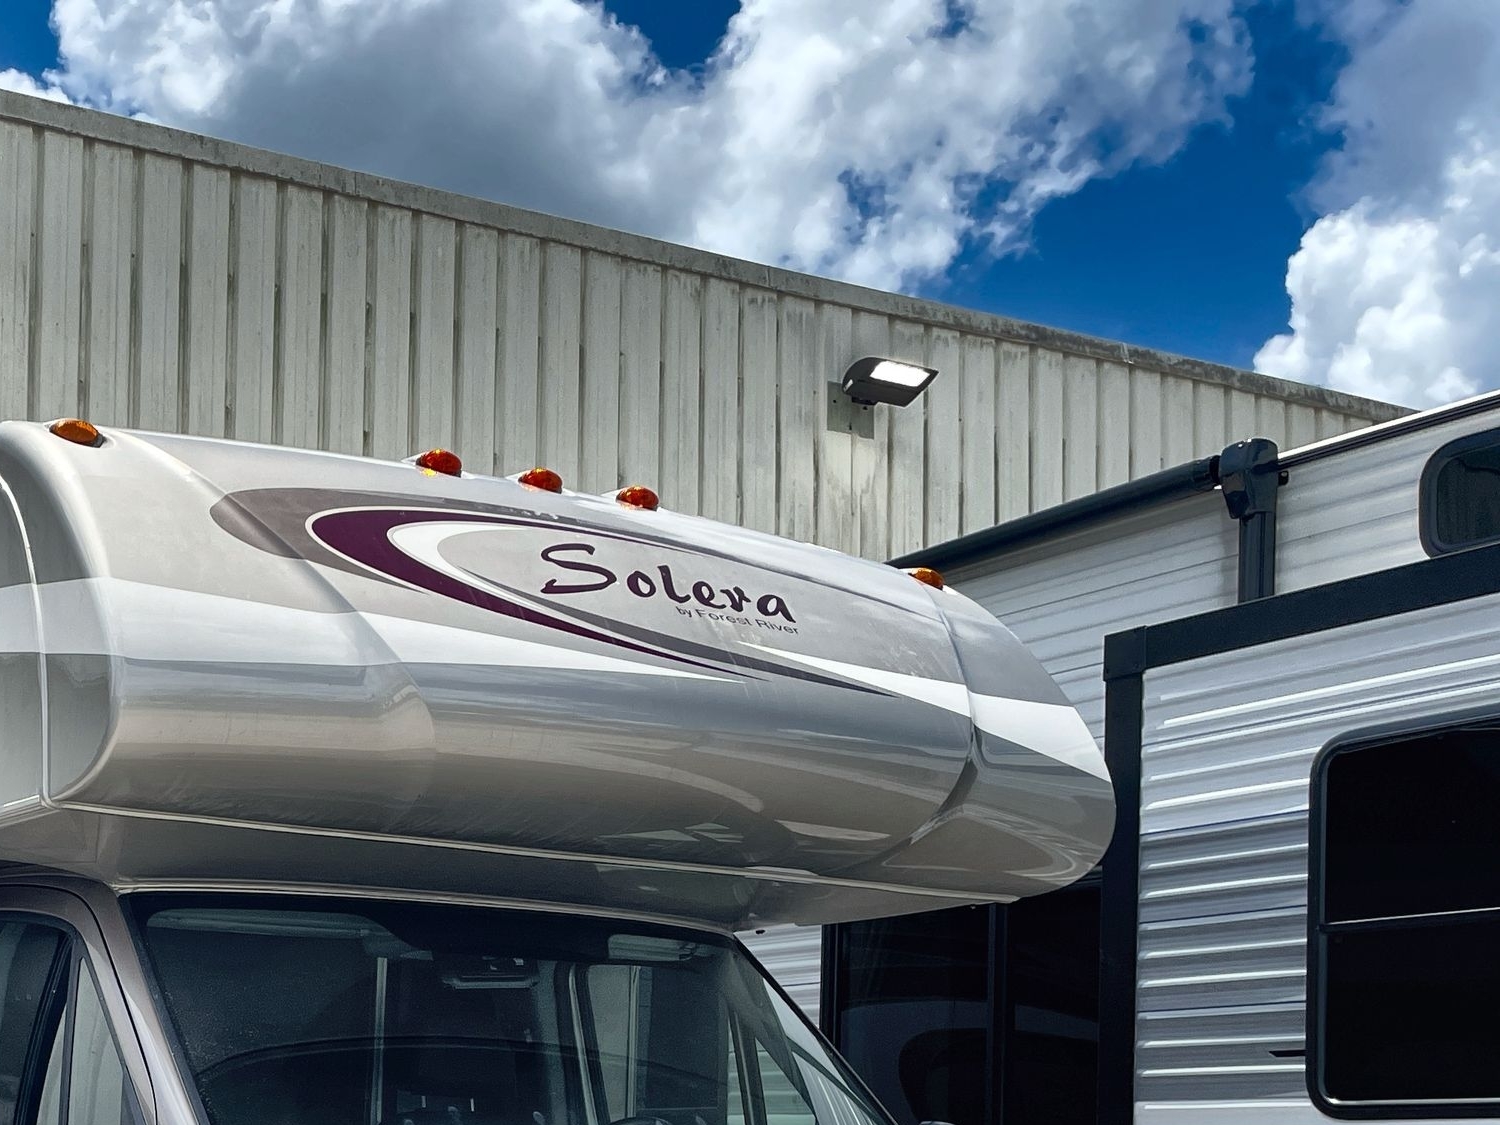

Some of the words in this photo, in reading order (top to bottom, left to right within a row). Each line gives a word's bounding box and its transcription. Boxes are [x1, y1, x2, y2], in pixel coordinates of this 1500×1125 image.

[540, 543, 797, 623] Solera
[675, 605, 693, 618] by
[695, 608, 753, 627] Forest
[755, 618, 799, 635] River
